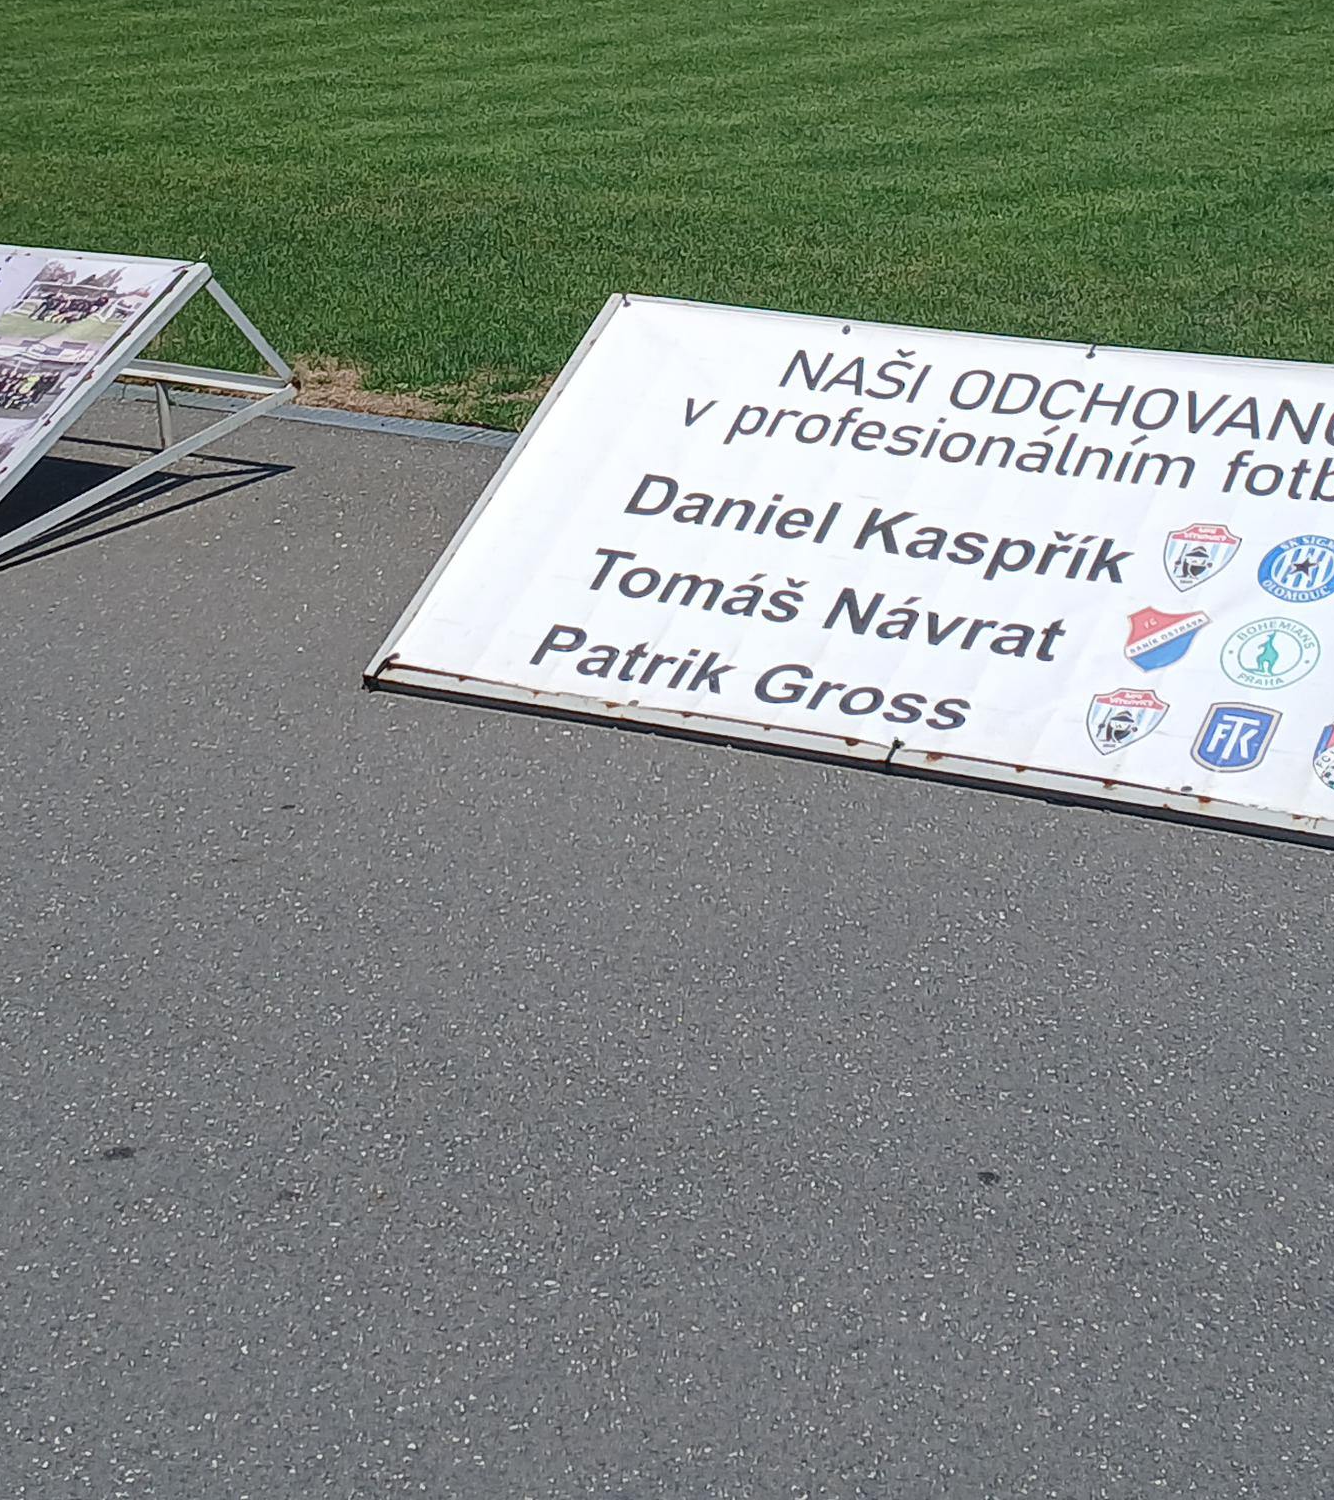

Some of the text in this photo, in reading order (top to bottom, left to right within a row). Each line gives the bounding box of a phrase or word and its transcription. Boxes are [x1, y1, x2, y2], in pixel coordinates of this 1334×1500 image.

[778, 348, 932, 403] NAŠI
[682, 397, 718, 427] v
[724, 396, 1197, 488] profesionálním
[624, 473, 1135, 584] Daniel Kaspřík
[1279, 539, 1300, 550] SK
[589, 547, 1067, 662] Tomáš Návrat
[1262, 580, 1330, 601] OLOMOUC
[1236, 620, 1316, 650] BOHEMIANS
[529, 623, 972, 731] Patrik Gross
[1237, 672, 1285, 687] PRAHA
[1316, 755, 1332, 770] FC
